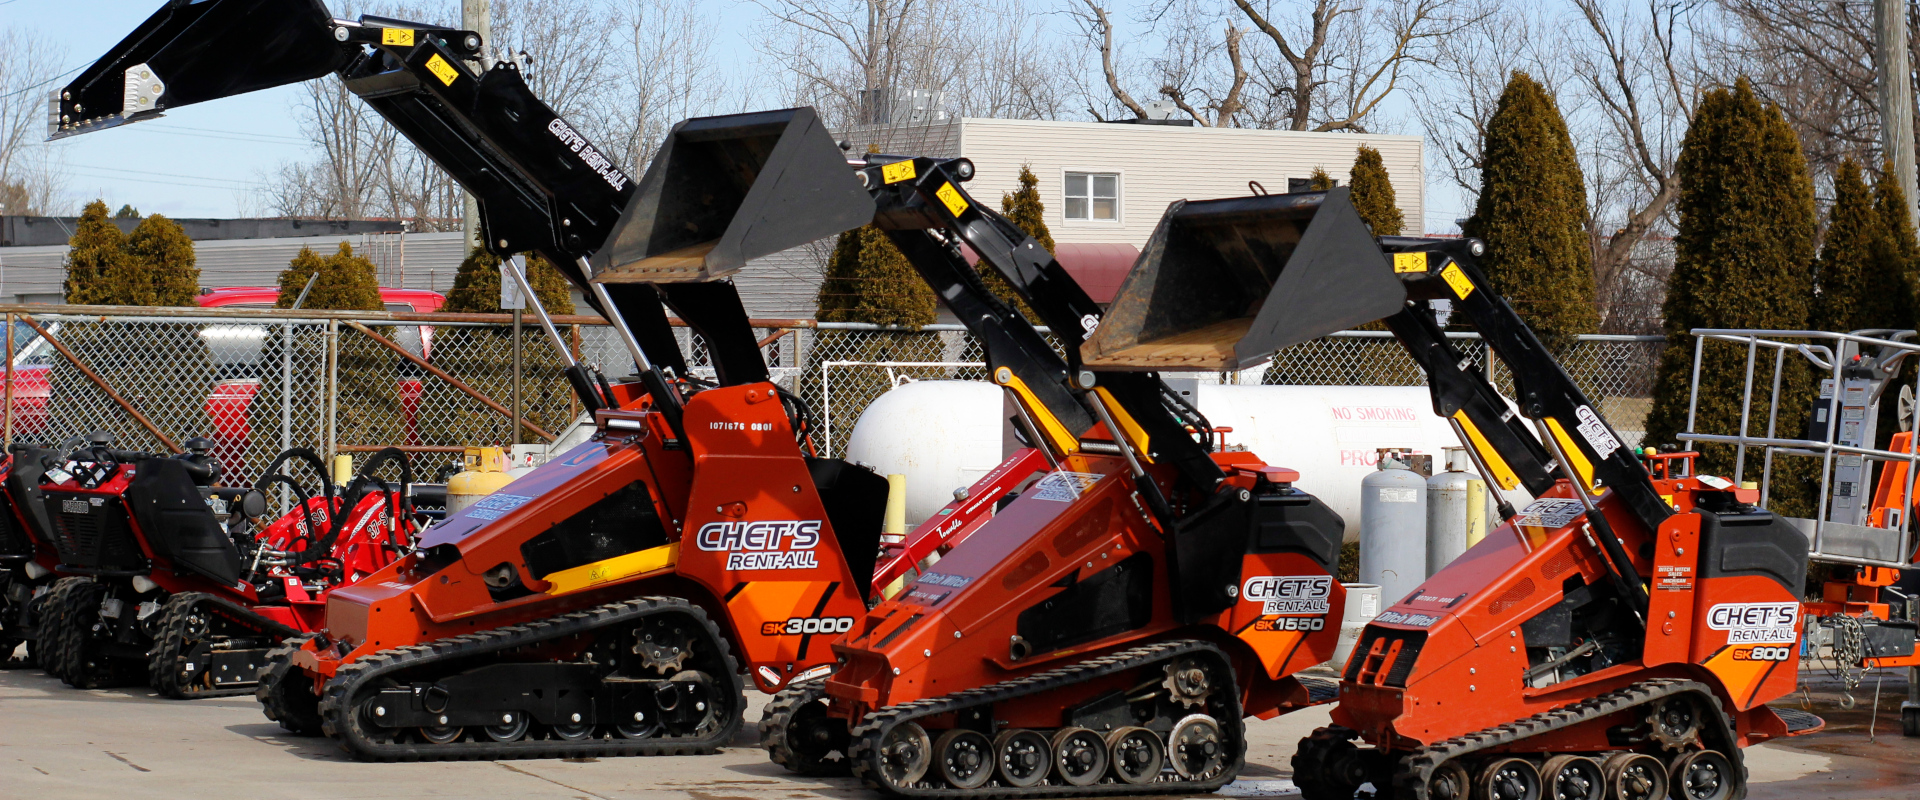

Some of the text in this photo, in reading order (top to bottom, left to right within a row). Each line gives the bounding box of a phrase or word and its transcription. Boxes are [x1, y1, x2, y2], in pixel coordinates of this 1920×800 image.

[548, 118, 587, 153] CHET'S
[1331, 407, 1416, 421] NO SMOKING
[710, 422, 772, 431] 1071676 0801
[1578, 408, 1617, 450] CHET'S
[697, 520, 821, 551] CHET'S
[935, 518, 963, 539] Towable
[727, 551, 818, 570] RENT-ALL
[916, 571, 974, 588] Ditch Witch
[1247, 577, 1329, 599] CHET'S
[1266, 599, 1327, 613] RENT-ALL
[1254, 617, 1325, 631] SK1550
[1374, 610, 1443, 628] Ditch Witch
[1711, 605, 1795, 627] CHET'S
[761, 617, 854, 635] SK3000
[1731, 627, 1793, 641] RENT-ALL
[1732, 646, 1790, 661] SK800
